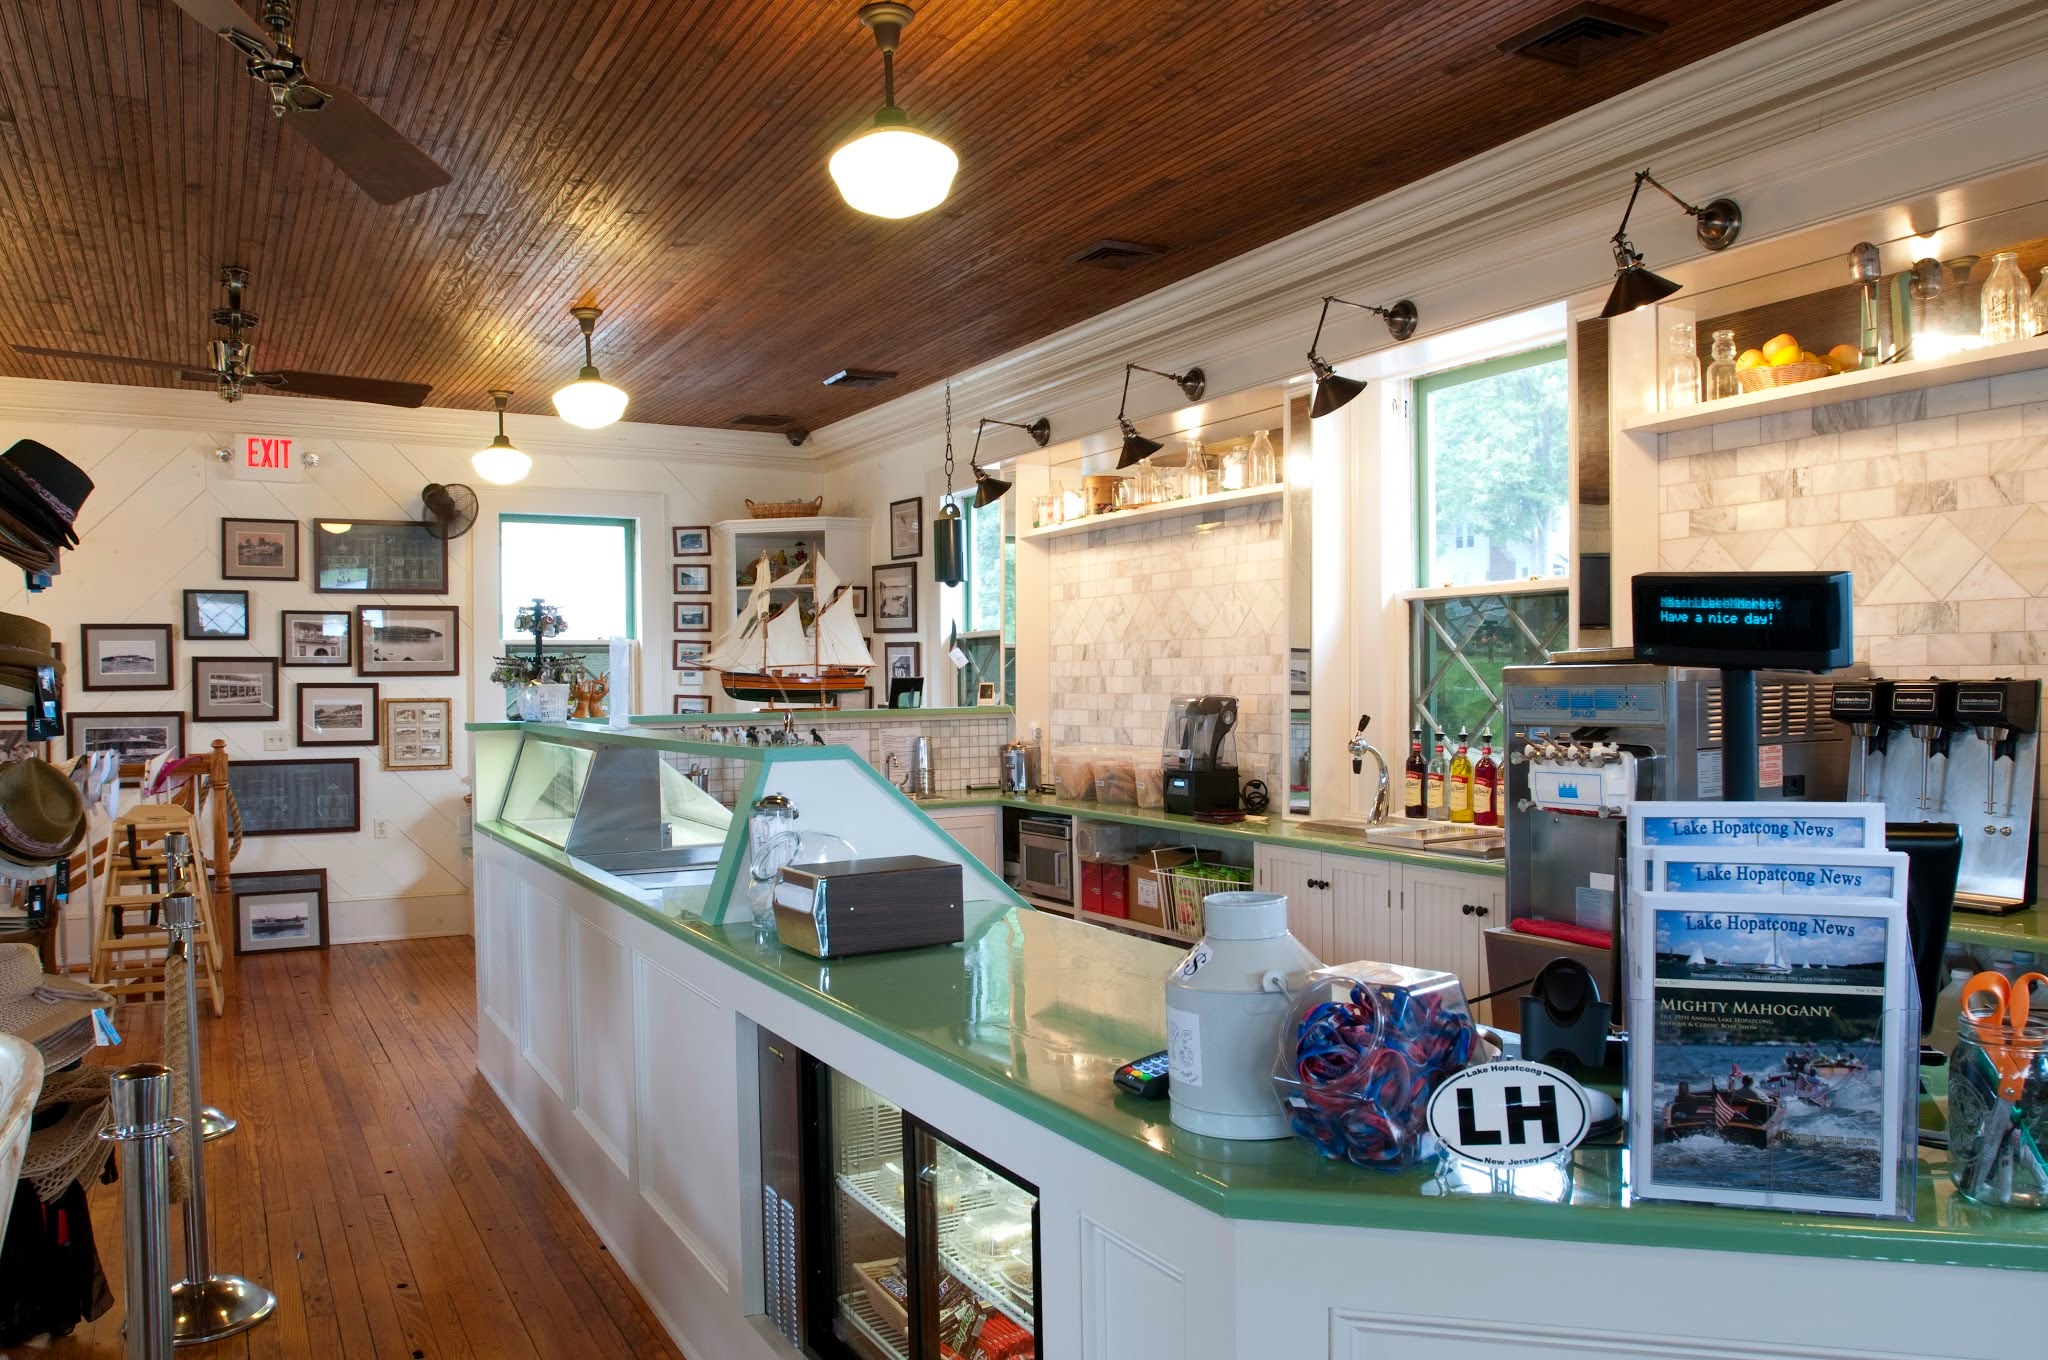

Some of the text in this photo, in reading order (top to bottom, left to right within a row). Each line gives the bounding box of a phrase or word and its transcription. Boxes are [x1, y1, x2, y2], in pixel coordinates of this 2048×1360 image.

[247, 437, 292, 469] EXIT
[1660, 611, 1773, 625] Have a nice day!
[1673, 820, 1834, 839] Lake Hopatcong News
[1695, 866, 1862, 887] Lake Hopatcong News
[1685, 915, 1855, 937] Lake Hopatcong News
[1660, 997, 1834, 1018] MIGHTY MAHOGANY
[1734, 1017, 1774, 1025] HOPATCONG
[1465, 1064, 1543, 1078] Lake Hopatcong
[1456, 1085, 1560, 1146] LH
[1484, 1156, 1540, 1166] New Jersey
